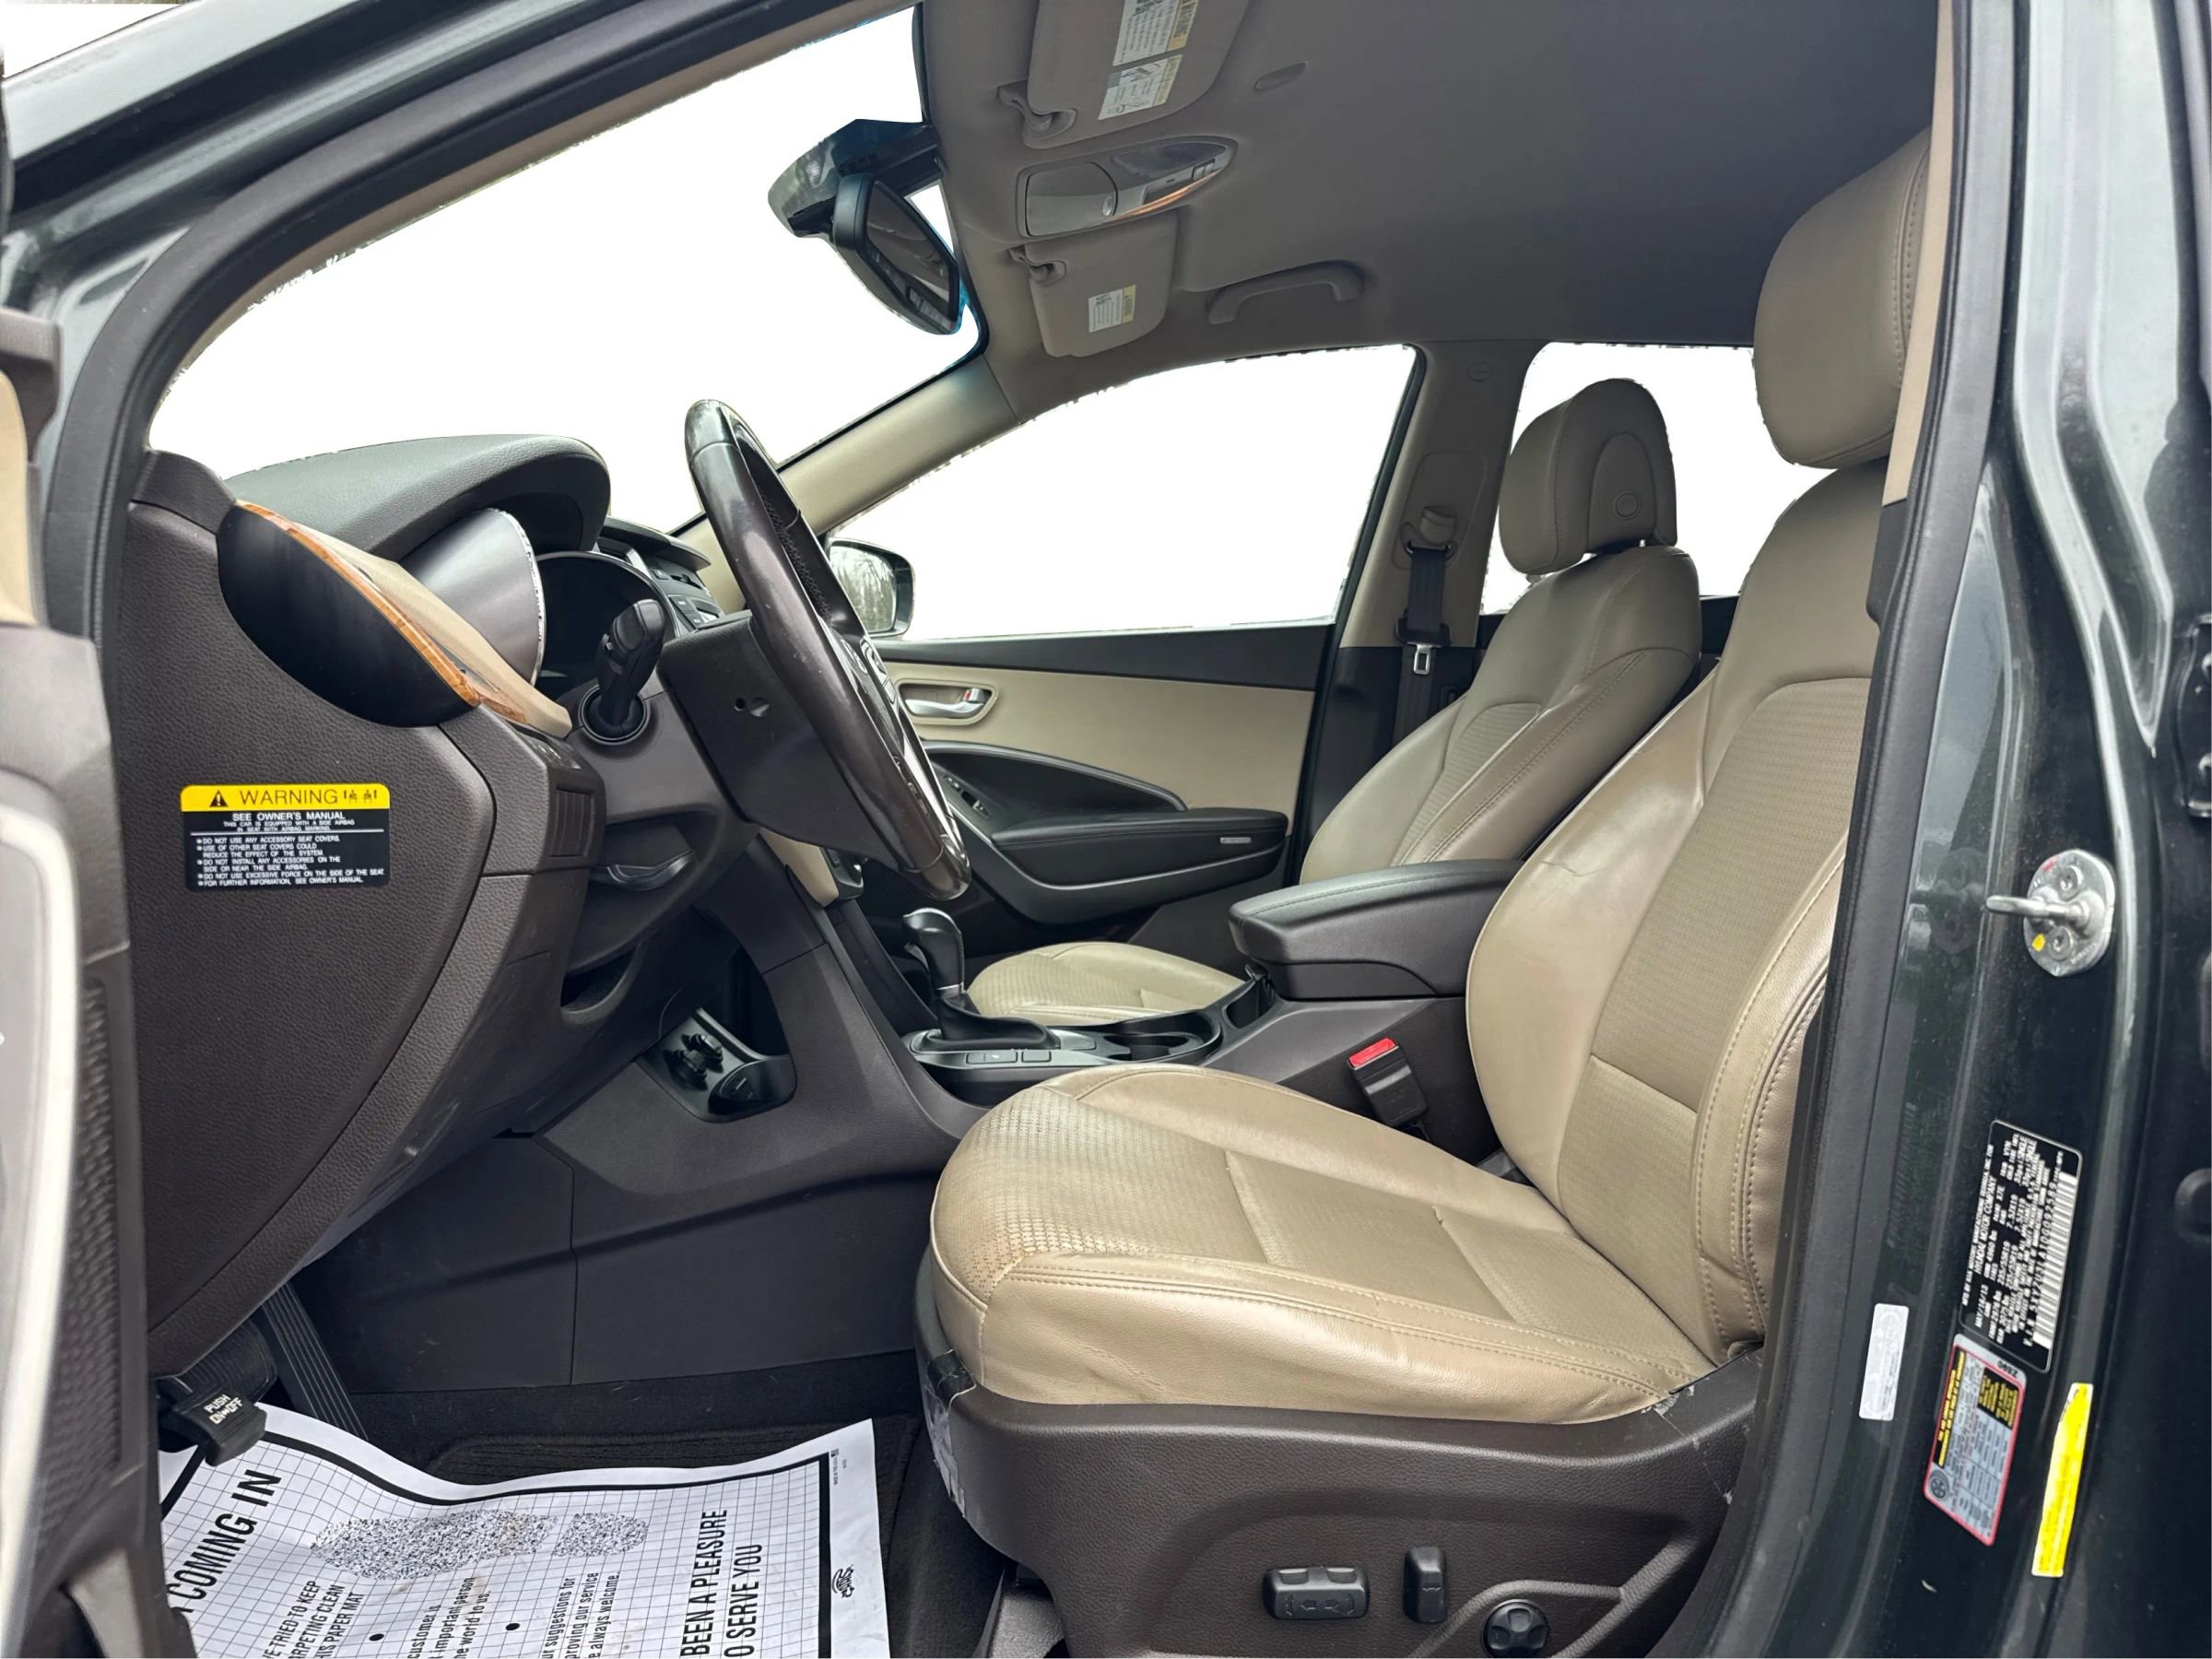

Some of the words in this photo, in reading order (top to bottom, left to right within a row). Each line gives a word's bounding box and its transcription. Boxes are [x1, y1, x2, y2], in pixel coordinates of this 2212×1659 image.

[239, 790, 338, 805] WARNING
[232, 813, 253, 821] SEE
[257, 812, 301, 821] OWNER'S
[306, 811, 345, 820] MANUAL
[2002, 1140, 2011, 1156] VYN
[1983, 1176, 1996, 1213] COMPANY
[1979, 1216, 1990, 1240] MOTOR
[1973, 1242, 1985, 1273] HYUNDAI
[1997, 1241, 2010, 1283] 235/55R19
[2005, 1244, 2018, 1288] 235/55R19
[204, 1394, 231, 1413] PUSH
[167, 1512, 258, 1600] COMING
[231, 1469, 281, 1507] IN
[691, 1510, 727, 1588] PLEASURE
[733, 1545, 762, 1578] YOU
[297, 1580, 322, 1605] KEEP
[340, 1592, 365, 1610] MAT
[481, 1590, 491, 1602] us.
[580, 1572, 599, 1604] service
[688, 1593, 717, 1604] A
[288, 1604, 308, 1617] TO
[288, 1615, 328, 1658] ARPETING
[317, 1583, 346, 1613] CLEAN
[430, 1606, 463, 1653] important
[455, 1577, 476, 1606] person
[468, 1606, 485, 1614] to
[545, 1590, 572, 1647] suggestions
[559, 1577, 576, 1590] for
[575, 1606, 590, 1619] our
[588, 1615, 611, 1649] always
[600, 1571, 620, 1613] welcome.
[726, 1582, 759, 1639] SERVE
[268, 1619, 300, 1647] TRIED
[324, 1613, 355, 1642] PAPER
[407, 1615, 436, 1658] customer
[425, 1604, 441, 1612] is
[459, 1618, 480, 1645] world
[565, 1623, 588, 1658] proving
[680, 1610, 714, 1656] BEEN
[314, 1644, 336, 1658] HIS
[453, 1648, 469, 1658] he
[724, 1645, 755, 1657] O
